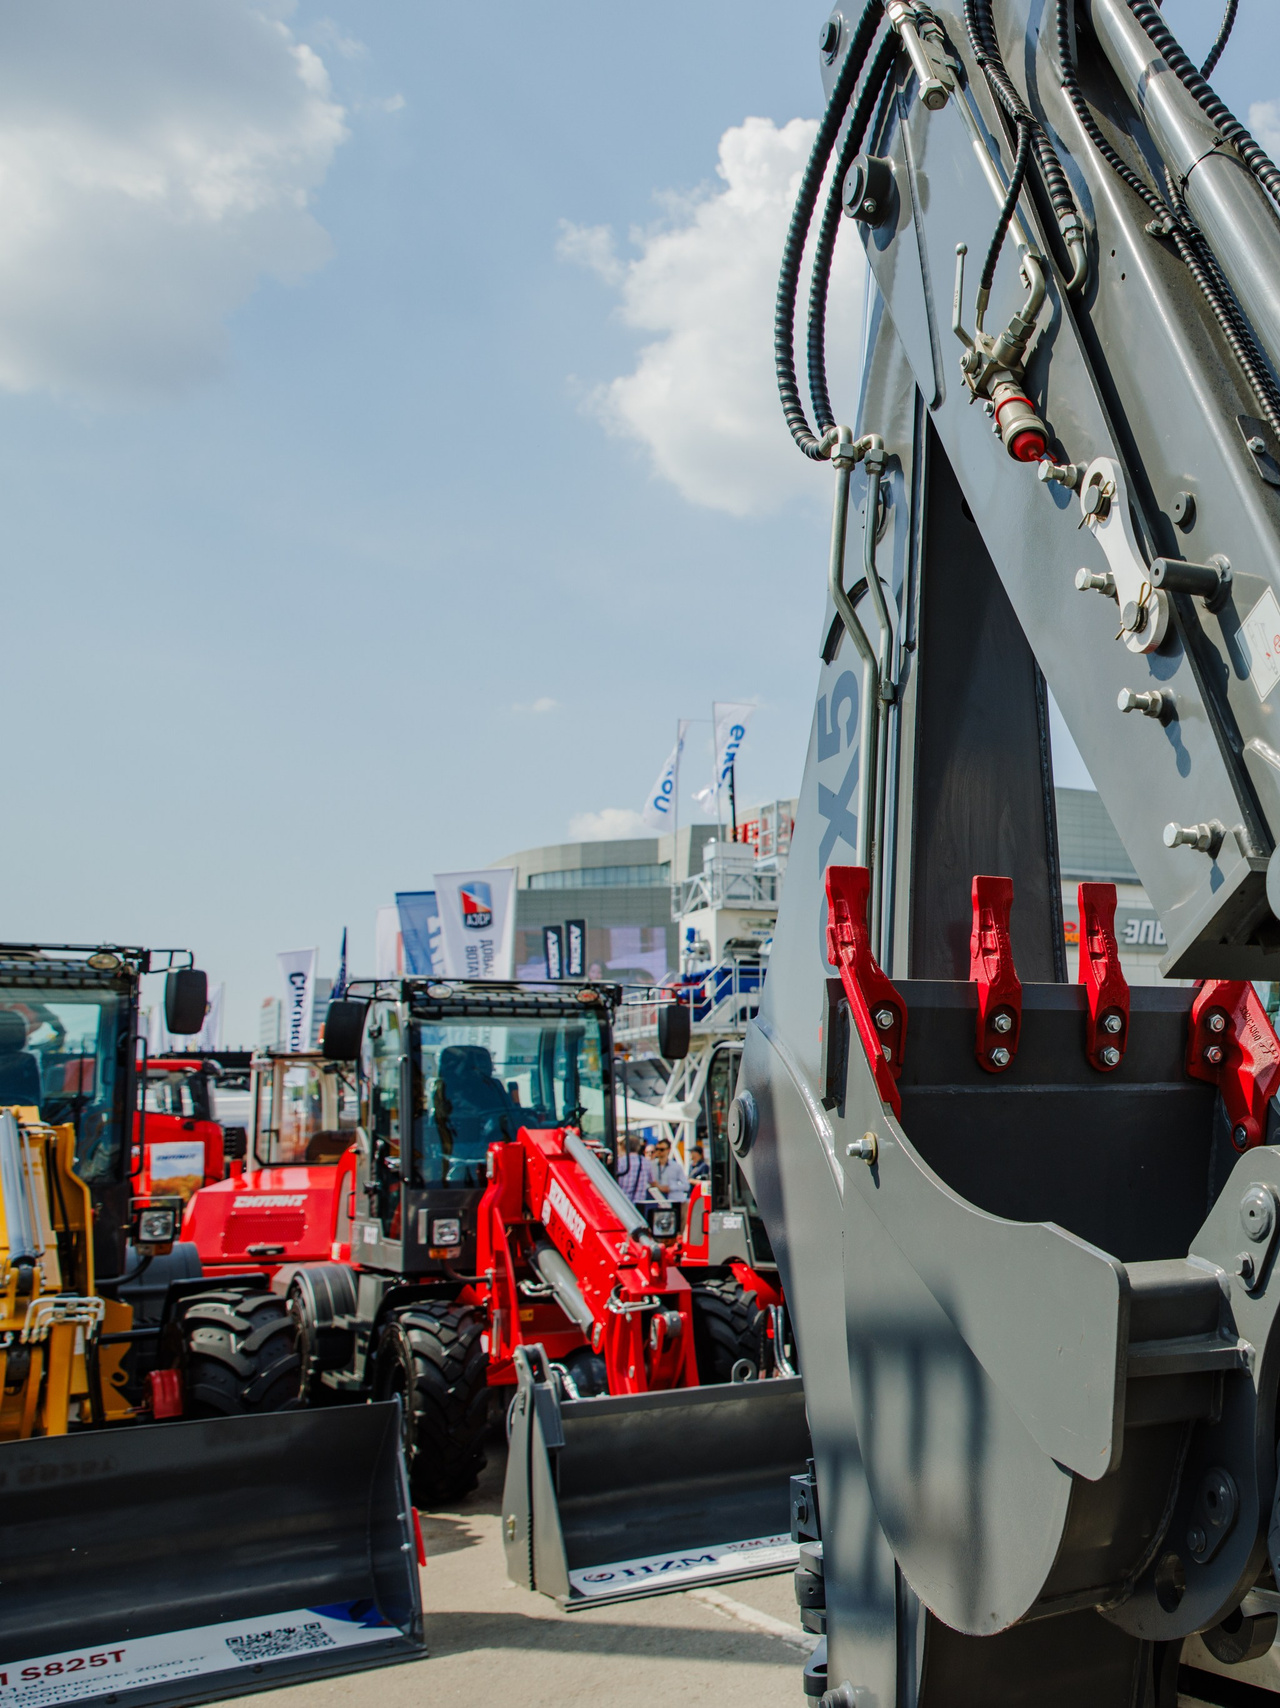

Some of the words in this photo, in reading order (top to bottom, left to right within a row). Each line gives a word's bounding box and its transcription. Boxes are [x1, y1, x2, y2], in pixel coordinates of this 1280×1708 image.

[818, 670, 861, 976] X5
[622, 1554, 718, 1577] HZM
[20, 1649, 127, 1681] S825T
[135, 1659, 184, 1673] 2000
